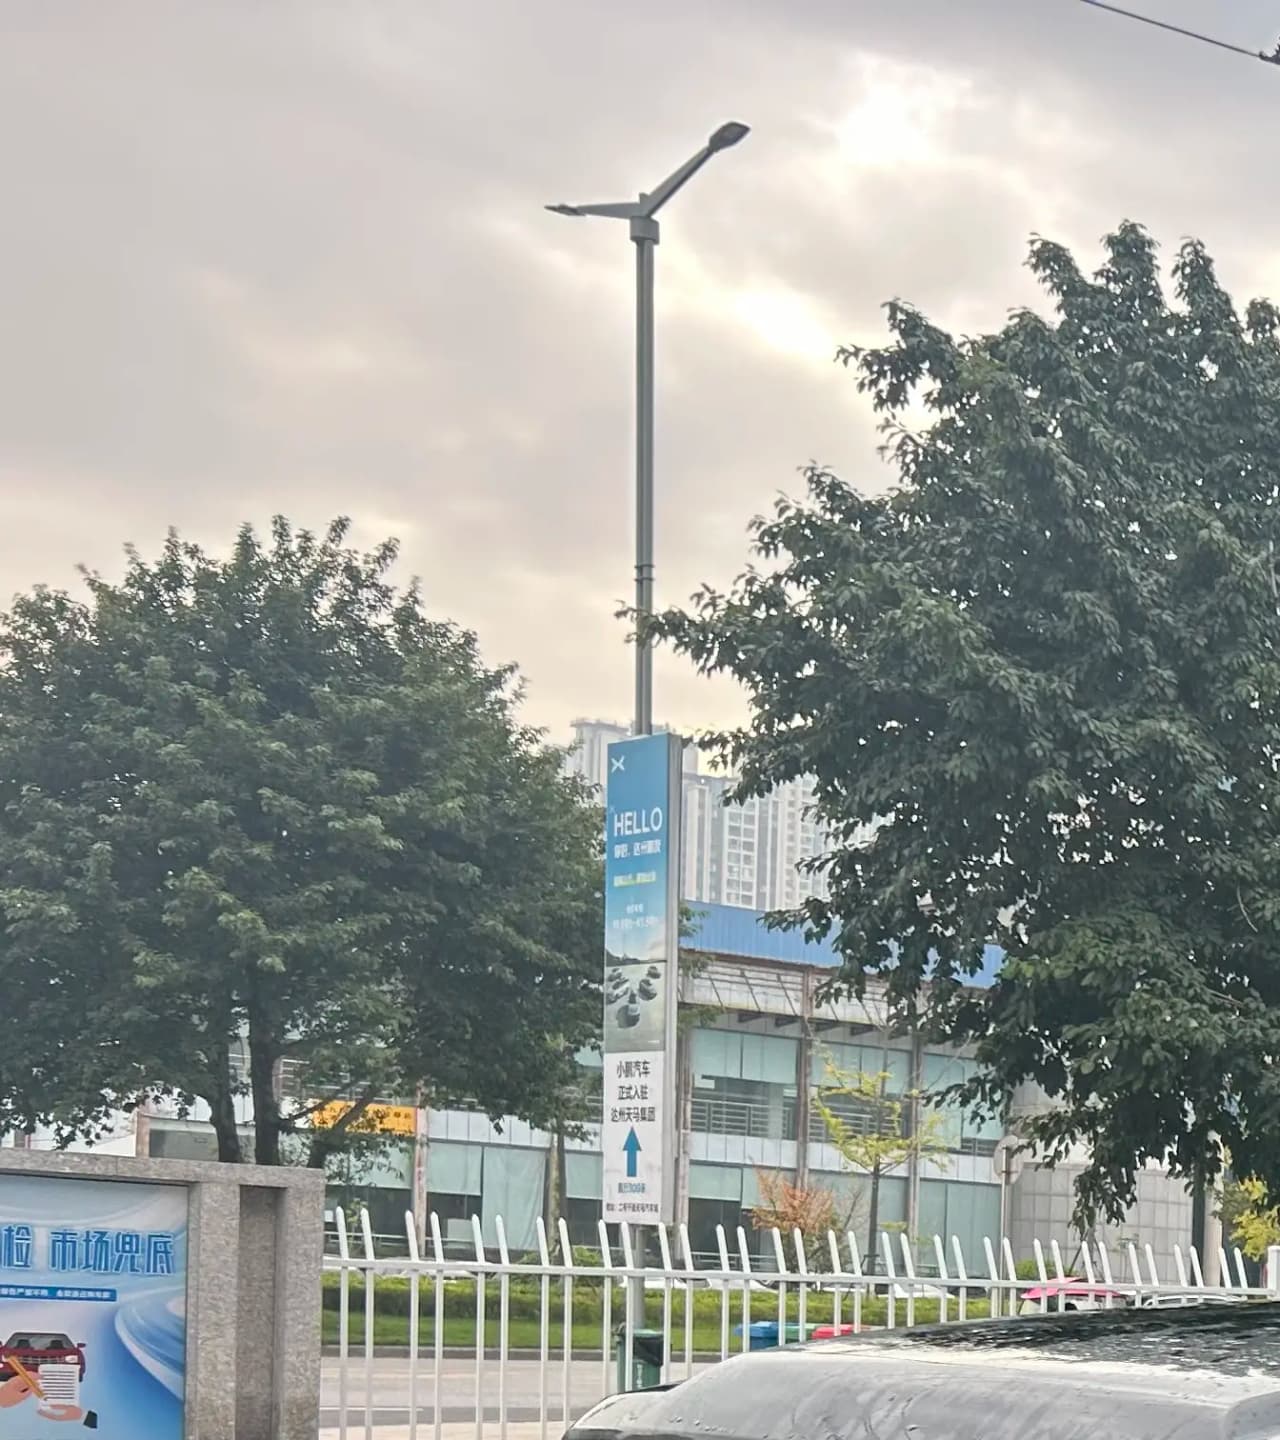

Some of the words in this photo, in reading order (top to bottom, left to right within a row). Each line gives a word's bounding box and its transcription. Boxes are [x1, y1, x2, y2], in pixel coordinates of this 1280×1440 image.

[613, 806, 663, 837] HELLO
[616, 1060, 651, 1079] 小鹏汽车
[617, 1085, 649, 1101] 正式入驻
[610, 1106, 656, 1123] 达州天马集团
[49, 1229, 174, 1275] 市场兜底
